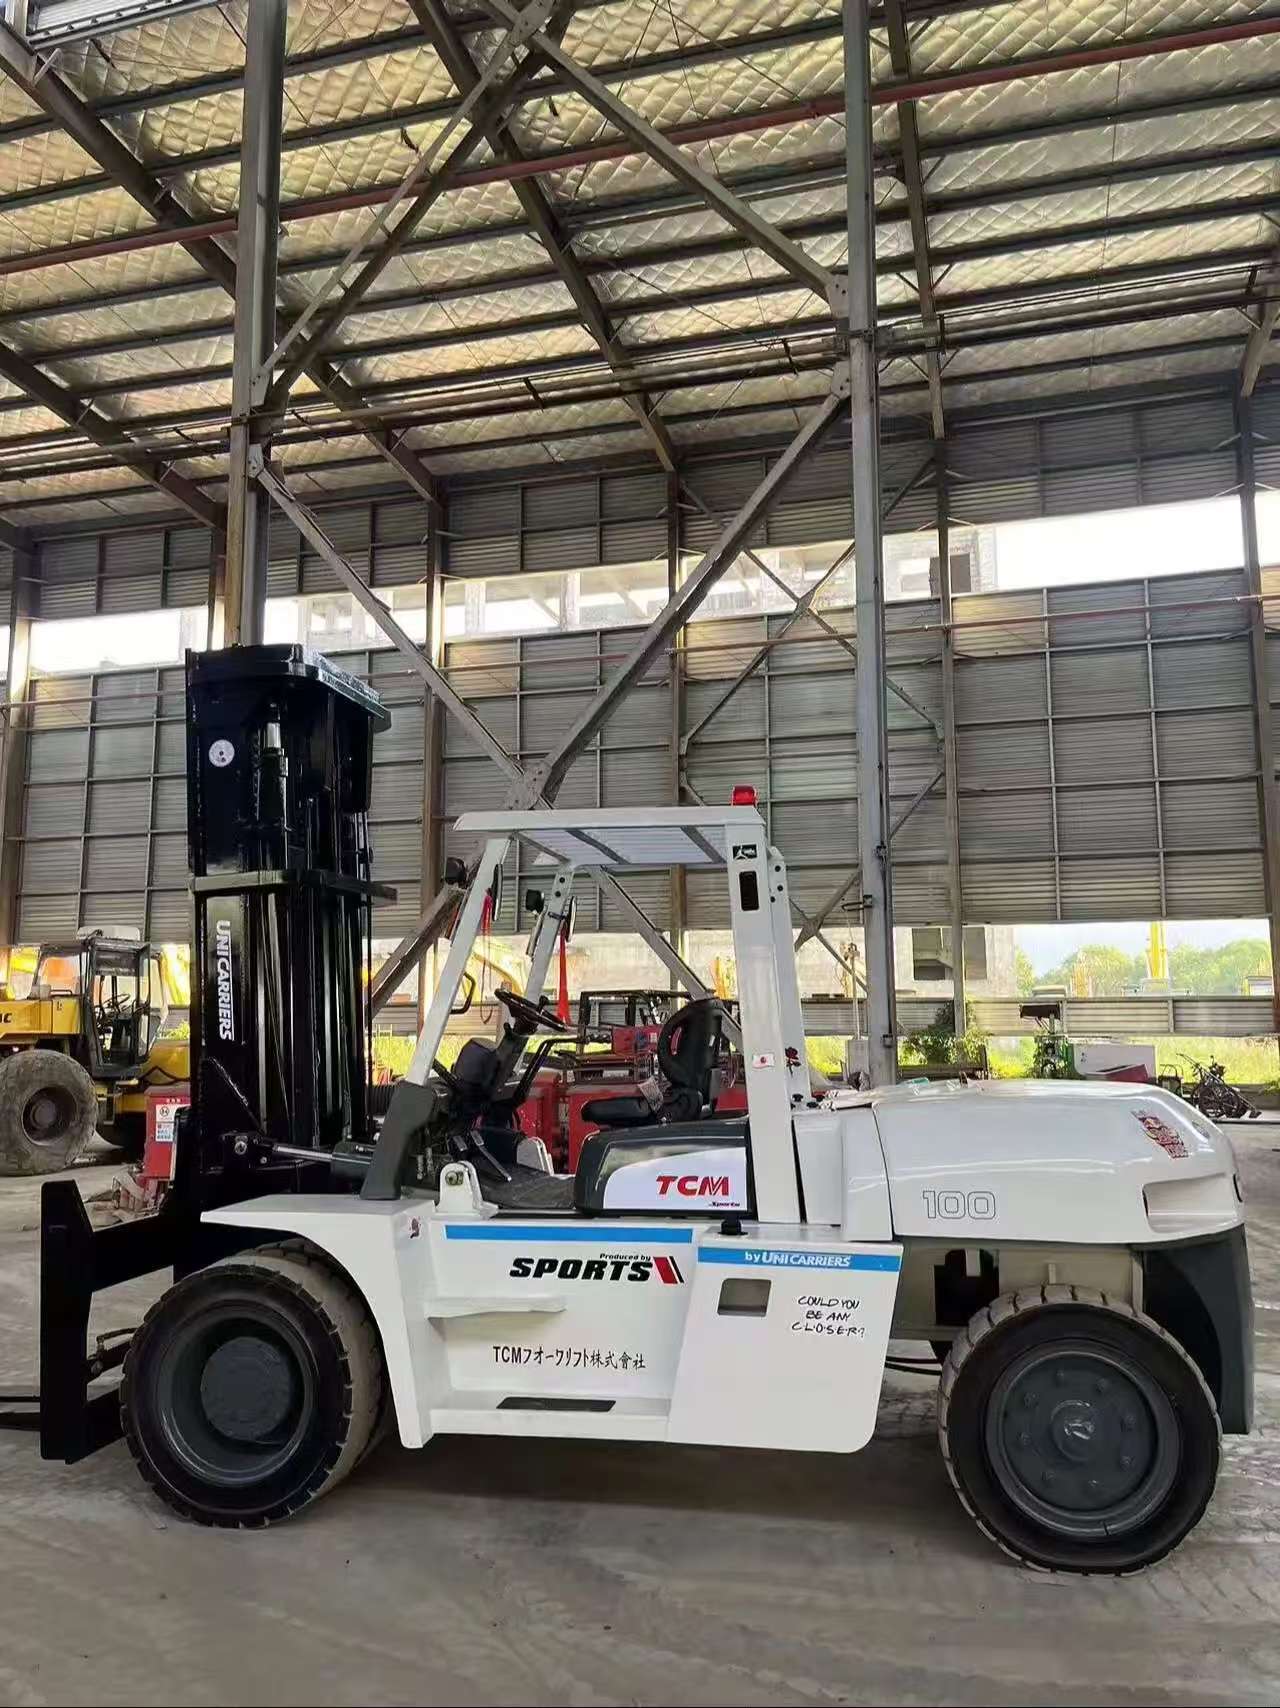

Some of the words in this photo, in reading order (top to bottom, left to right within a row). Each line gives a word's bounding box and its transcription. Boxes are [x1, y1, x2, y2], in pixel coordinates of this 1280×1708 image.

[217, 920, 233, 1040] UNICARRIERS
[656, 1176, 729, 1196] TCM
[923, 1190, 995, 1219] 100
[745, 1251, 760, 1263] by
[762, 1251, 851, 1267] UNICARRIERS
[510, 1258, 653, 1281] SPORTS
[798, 1296, 839, 1307] COULD
[841, 1299, 860, 1309] YOU
[806, 1310, 823, 1319] BE
[826, 1312, 851, 1322] ANY
